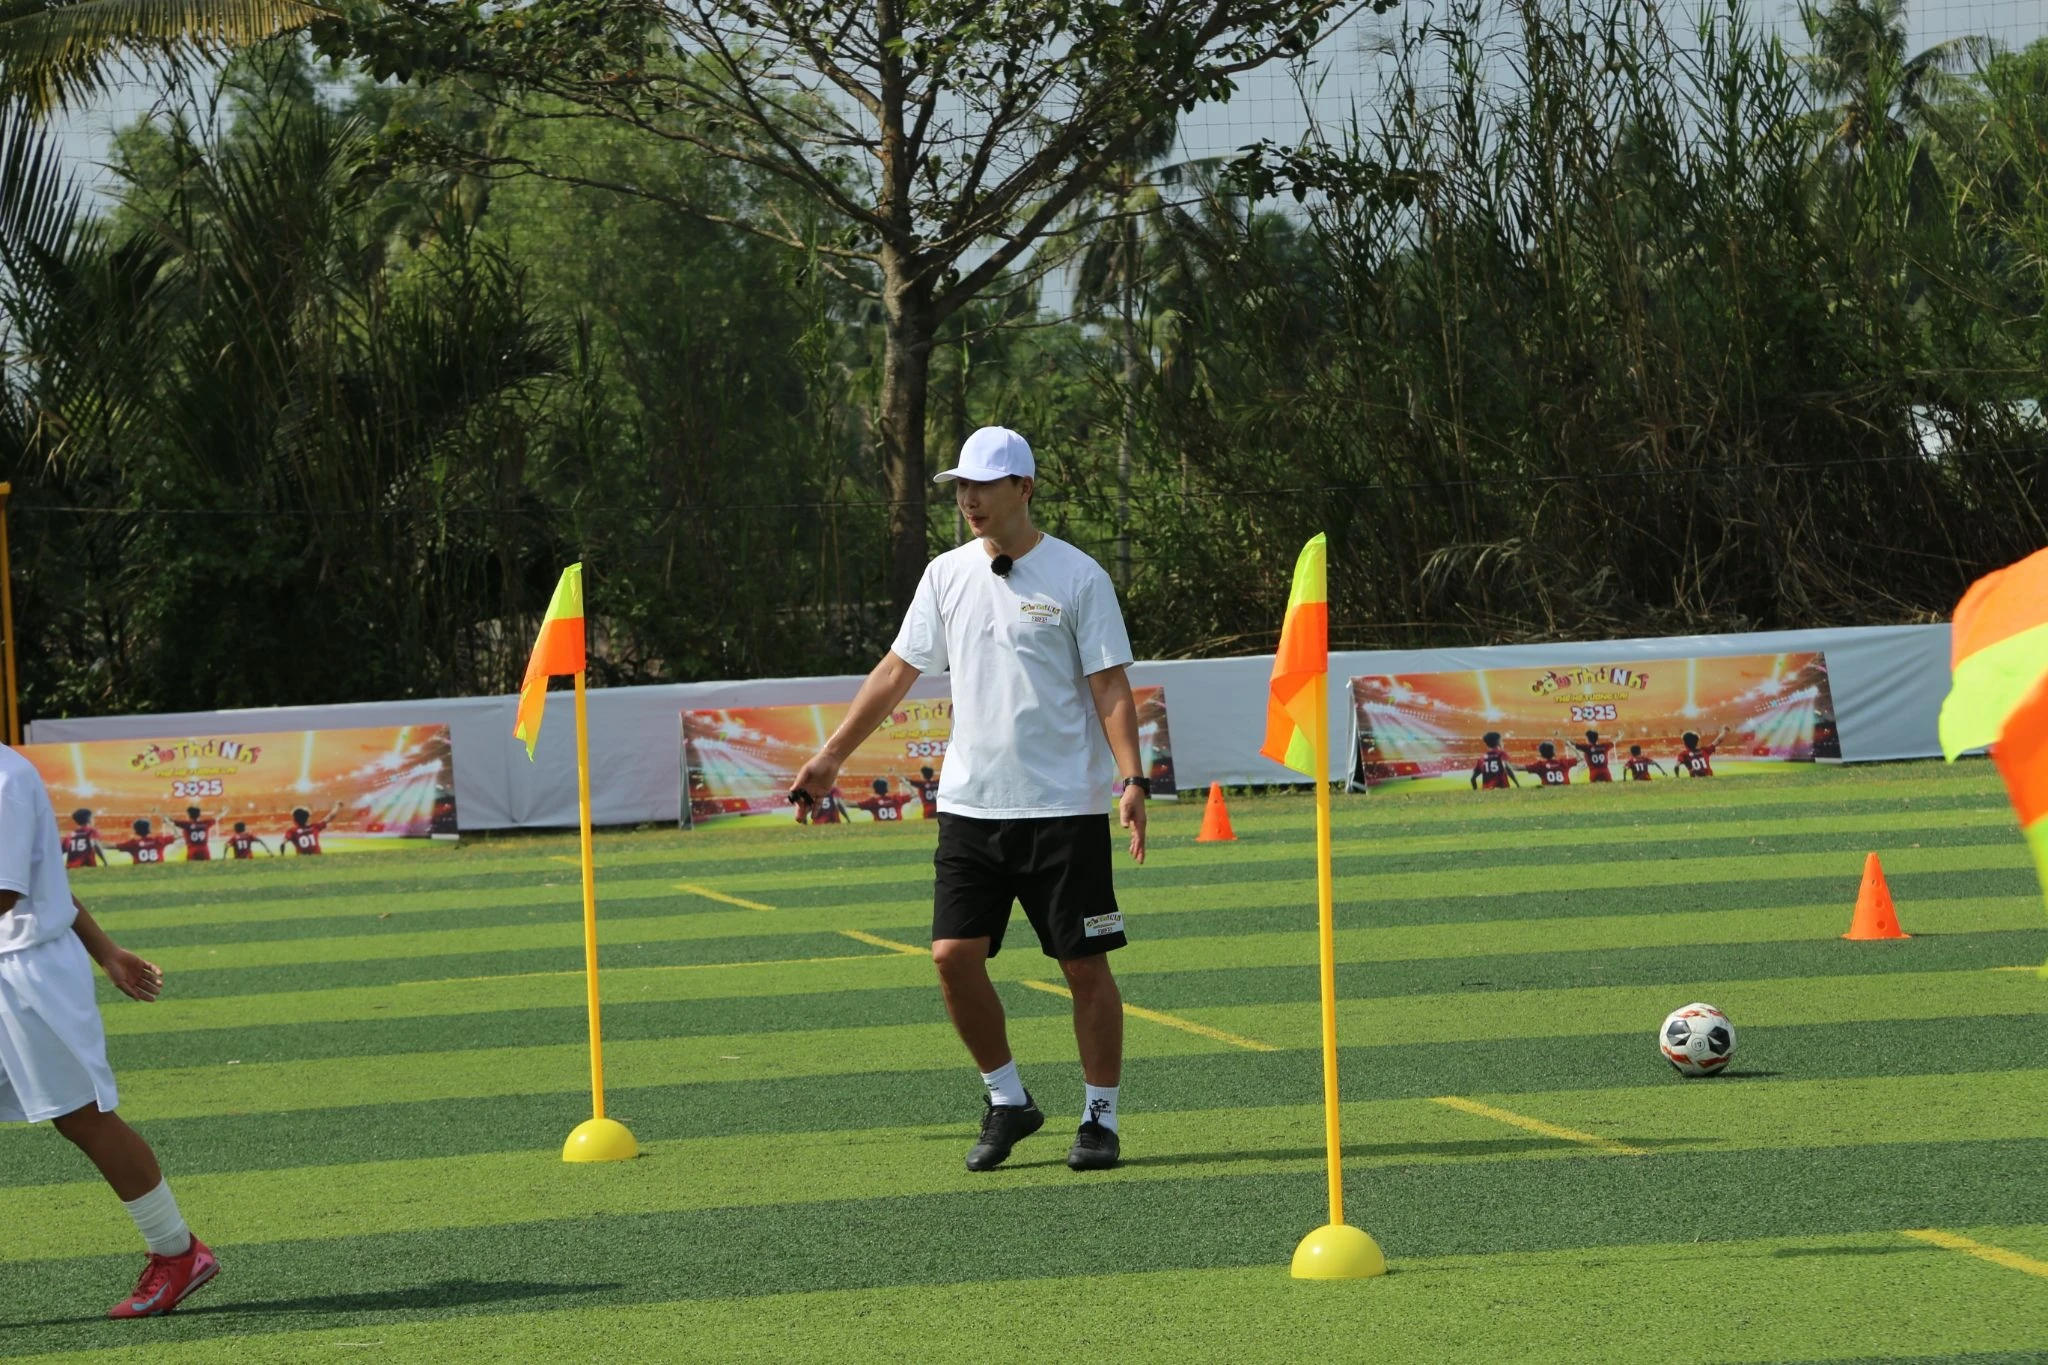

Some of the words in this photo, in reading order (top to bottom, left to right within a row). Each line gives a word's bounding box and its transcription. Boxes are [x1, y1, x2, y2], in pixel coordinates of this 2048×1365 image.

[1571, 704, 1618, 722] 2025
[1591, 753, 1606, 765] 09
[1691, 757, 1708, 771] 01
[1483, 760, 1500, 773] 15
[1634, 762, 1645, 772] 11
[1546, 770, 1564, 783] 08
[172, 778, 223, 798] 2025
[878, 807, 898, 819] 08
[190, 831, 206, 842] 09
[299, 835, 316, 848] 01
[70, 839, 87, 851] 15
[237, 840, 249, 850] 11
[138, 850, 158, 862] 08
